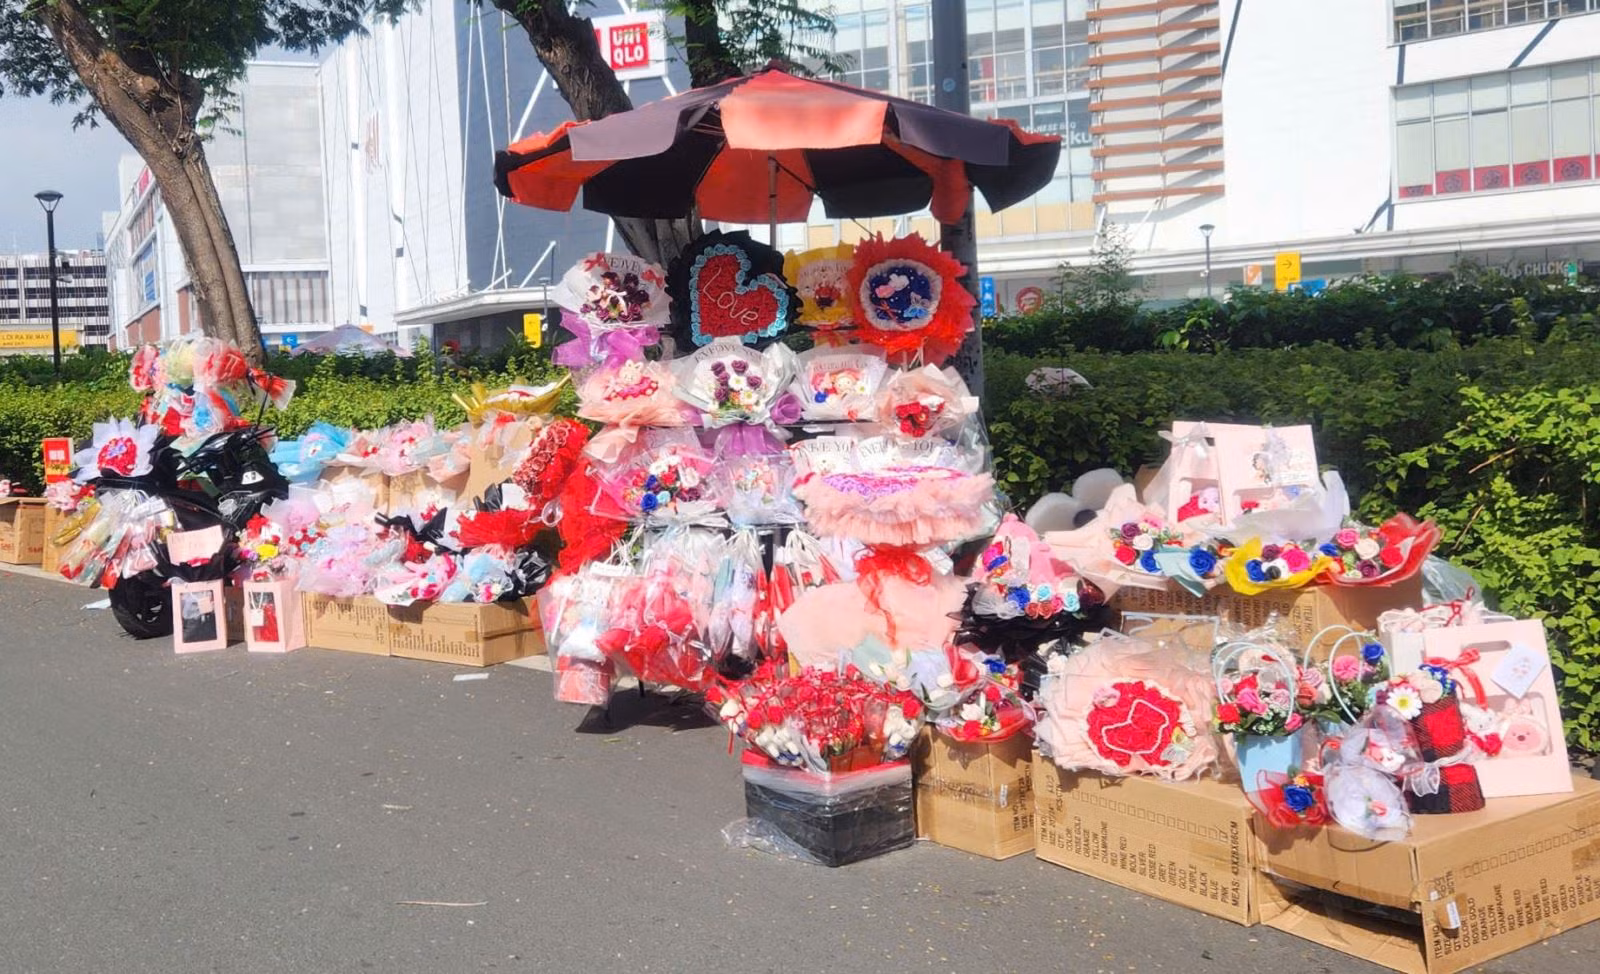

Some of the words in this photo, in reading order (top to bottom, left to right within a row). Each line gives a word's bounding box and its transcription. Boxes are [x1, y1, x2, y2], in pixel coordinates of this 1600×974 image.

[613, 44, 645, 66] QLO
[703, 267, 759, 326] Love
[1091, 832, 1099, 861] YELLOW
[1119, 836, 1127, 851] RED
[1148, 844, 1156, 859] RED
[1110, 852, 1118, 867] RED
[1119, 852, 1127, 870] WINE
[1138, 851, 1147, 876] SILVER
[1149, 859, 1157, 880] ROSE
[1158, 863, 1167, 883] GREY
[1168, 861, 1176, 886] GREEN
[1178, 869, 1187, 889] GOLD
[1189, 863, 1197, 893] PURPLE
[1199, 872, 1208, 897] BLACK
[1210, 879, 1218, 900] BLUE
[1220, 885, 1229, 904] PINK
[1231, 879, 1240, 907] MEAS:
[1513, 889, 1522, 906] RED
[1560, 884, 1569, 912] GREEN
[1568, 886, 1577, 909] GOLD
[1575, 874, 1585, 905] PURPLE
[1584, 875, 1594, 903] BLACK
[1468, 897, 1476, 921] GOLD
[1493, 884, 1507, 935] CHAMPAGNE
[1525, 902, 1534, 925] BOLN
[1532, 893, 1542, 922] SILVER
[1542, 895, 1550, 918] ROSE
[1551, 893, 1560, 915] GREY
[1478, 906, 1489, 941] ORANGE
[1487, 904, 1498, 938] YELLOW
[1507, 914, 1515, 931] RED
[1516, 907, 1524, 928] WINE
[1471, 922, 1479, 945] ROSE
[1434, 940, 1443, 959] ITEM
